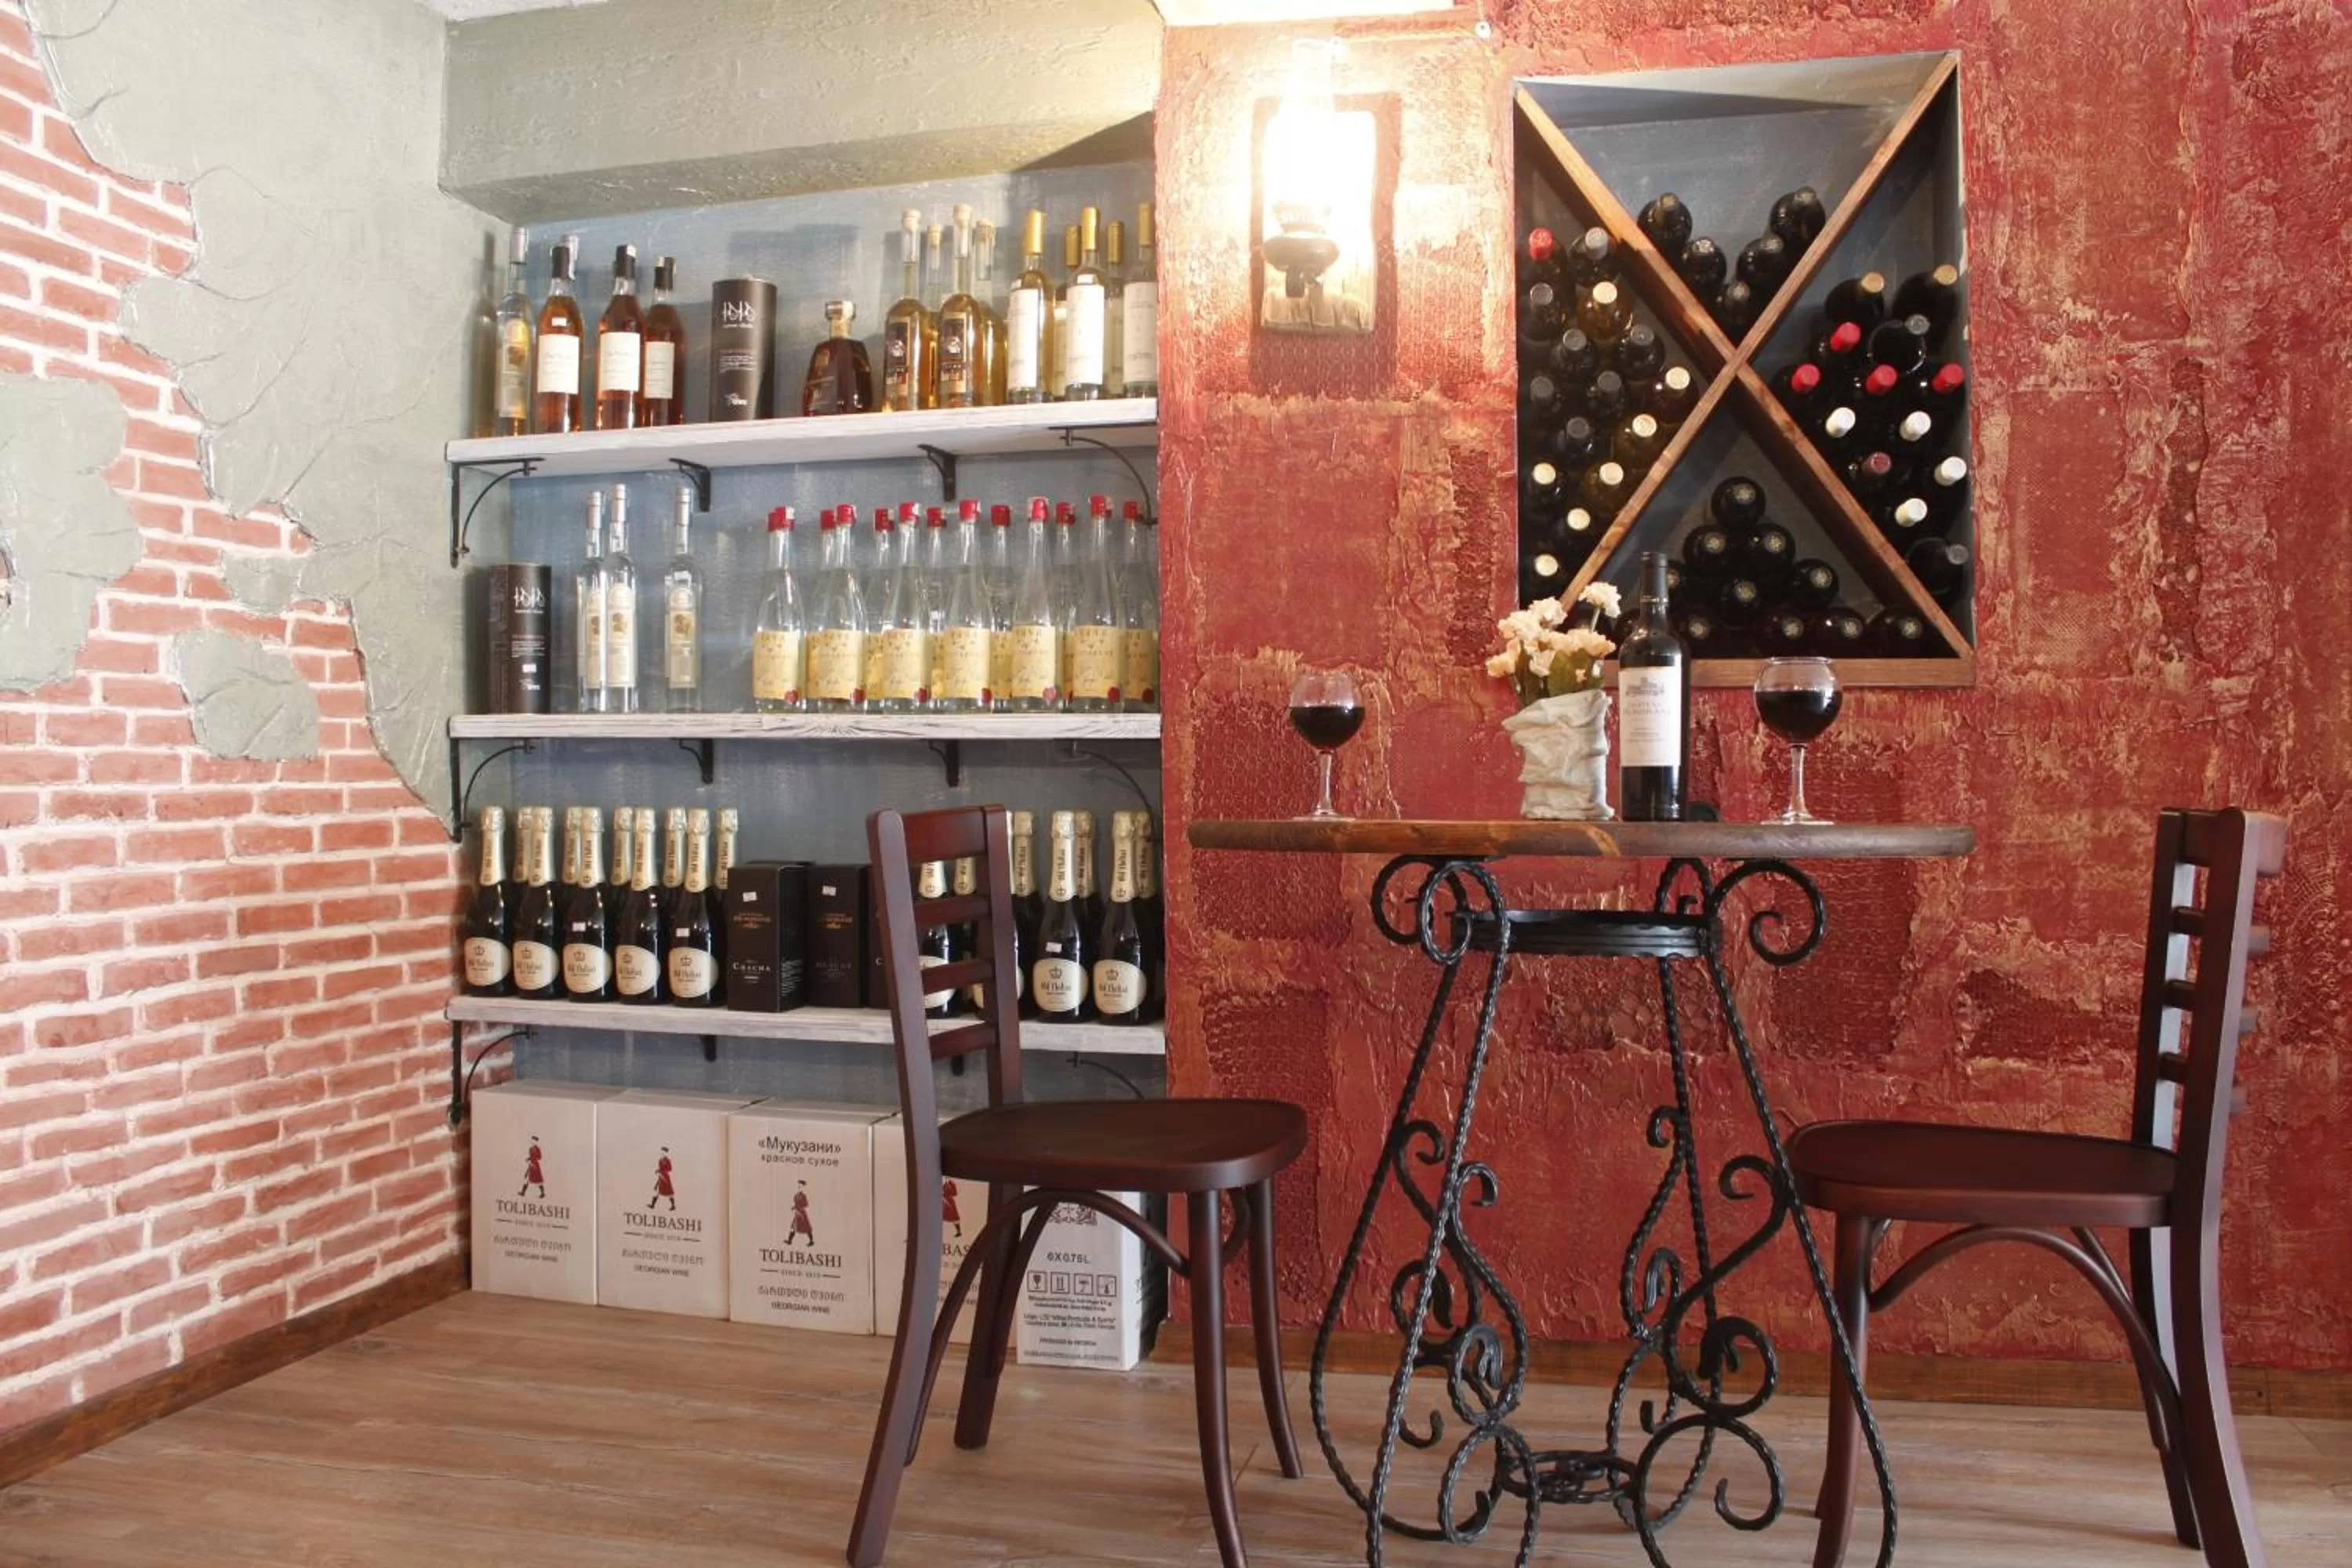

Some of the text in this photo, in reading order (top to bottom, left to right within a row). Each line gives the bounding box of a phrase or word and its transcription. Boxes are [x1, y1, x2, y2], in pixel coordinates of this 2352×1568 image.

[758, 1135, 841, 1155] «Мукузани»
[760, 1154, 840, 1167] красное сухое
[495, 1199, 571, 1219] TOLIBASHI
[622, 1211, 702, 1232] TOLIBASHI
[758, 1248, 842, 1268] TOLIBASHI
